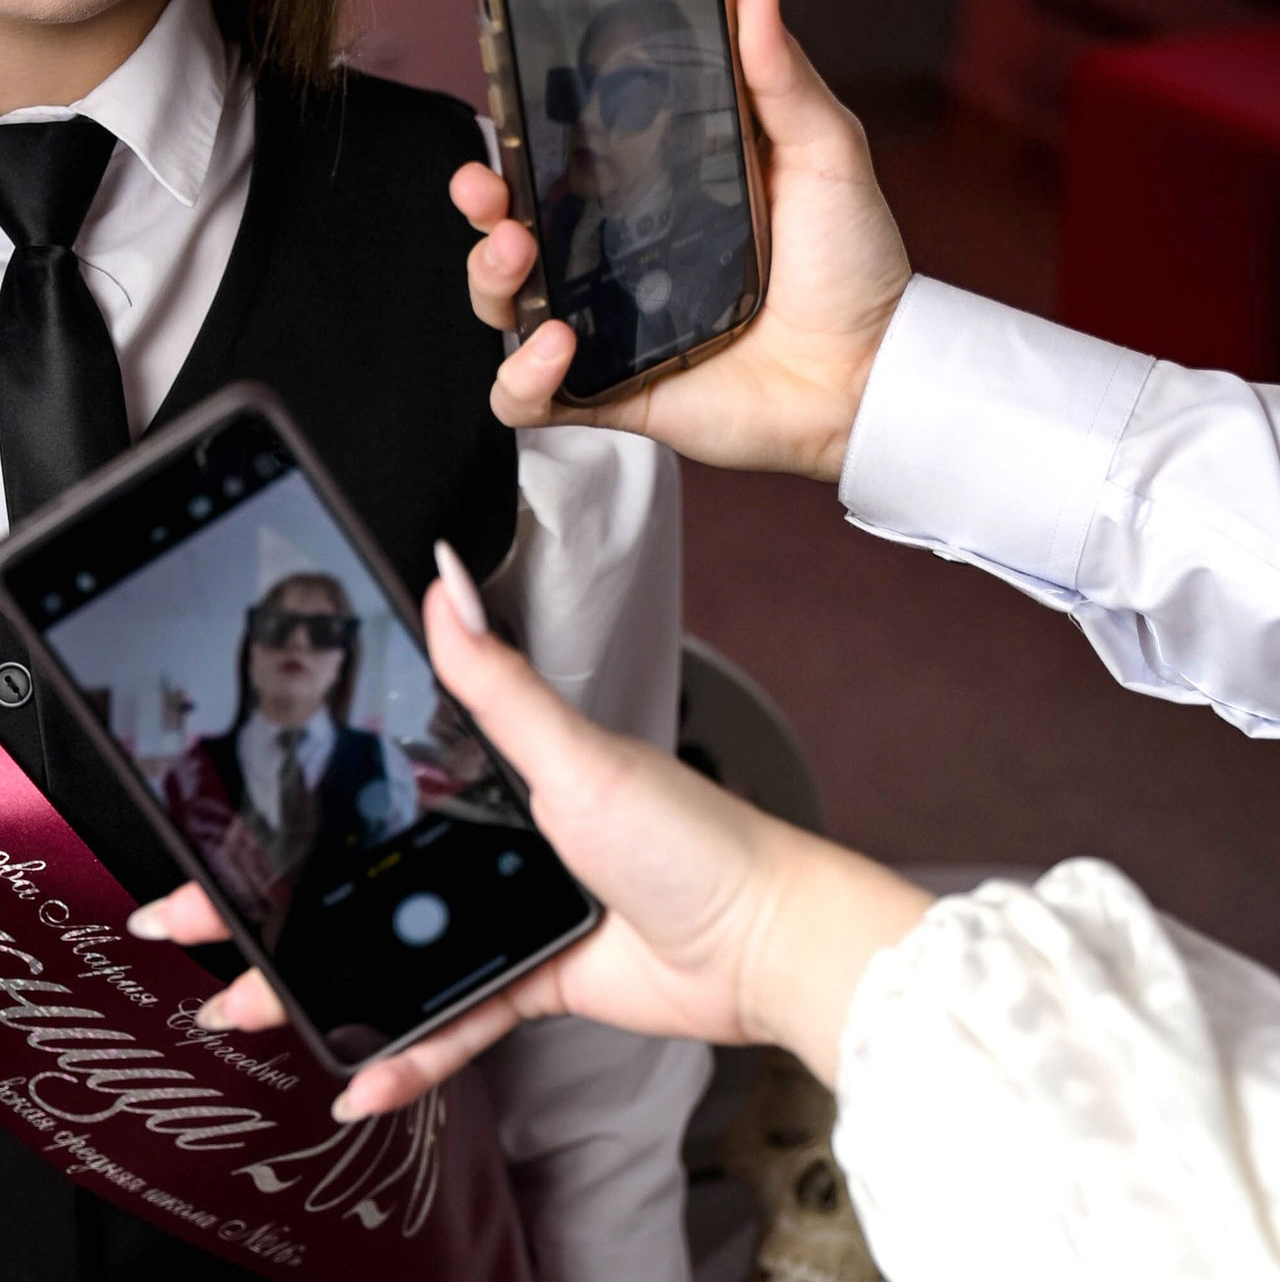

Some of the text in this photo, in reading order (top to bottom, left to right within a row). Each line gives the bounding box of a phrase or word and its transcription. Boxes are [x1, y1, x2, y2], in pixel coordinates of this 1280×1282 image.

[39, 899, 159, 1007] Мария
[167, 997, 301, 1092] Сергеевна
[43, 1127, 147, 1193] средняя
[141, 1183, 217, 1229] школа
